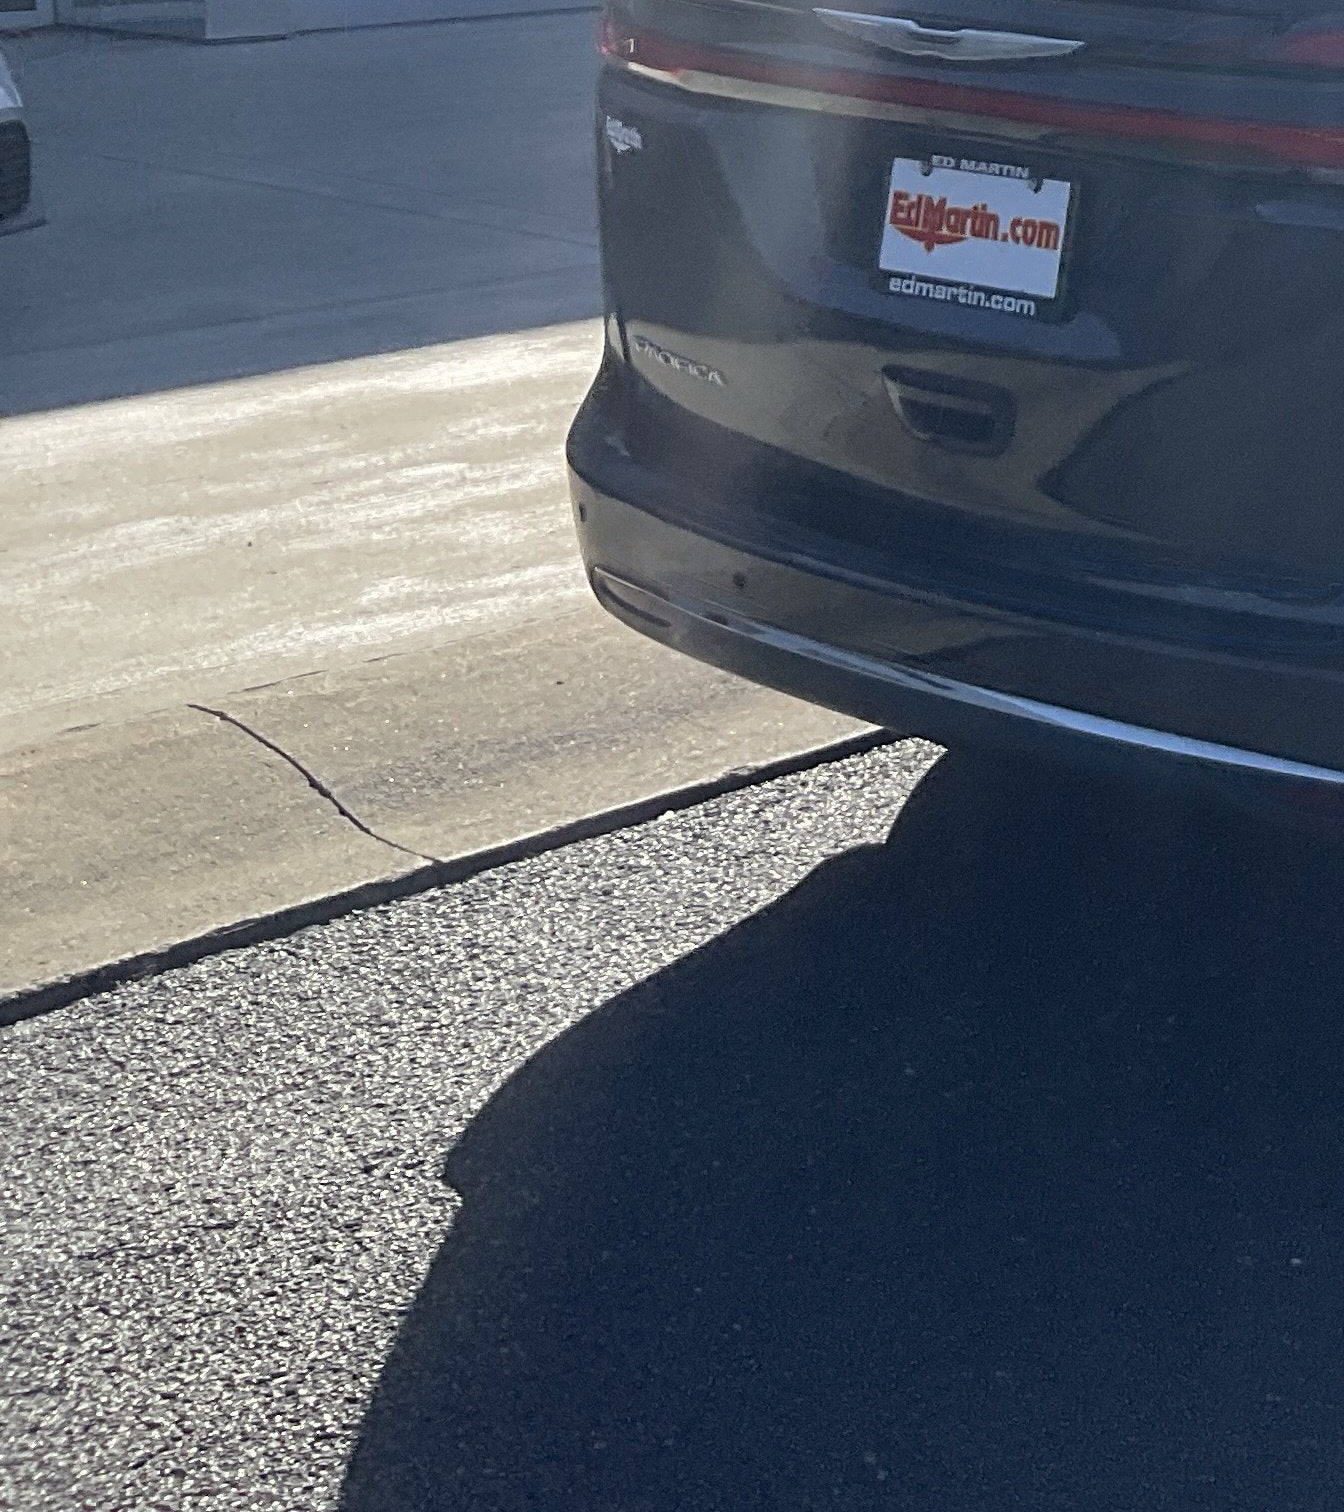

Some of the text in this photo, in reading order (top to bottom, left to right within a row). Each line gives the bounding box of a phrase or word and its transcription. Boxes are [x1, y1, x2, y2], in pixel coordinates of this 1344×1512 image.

[931, 155, 1030, 179] ED MARTIN
[889, 190, 1061, 250] EdMartin.com
[888, 275, 1036, 316] edmartin.com
